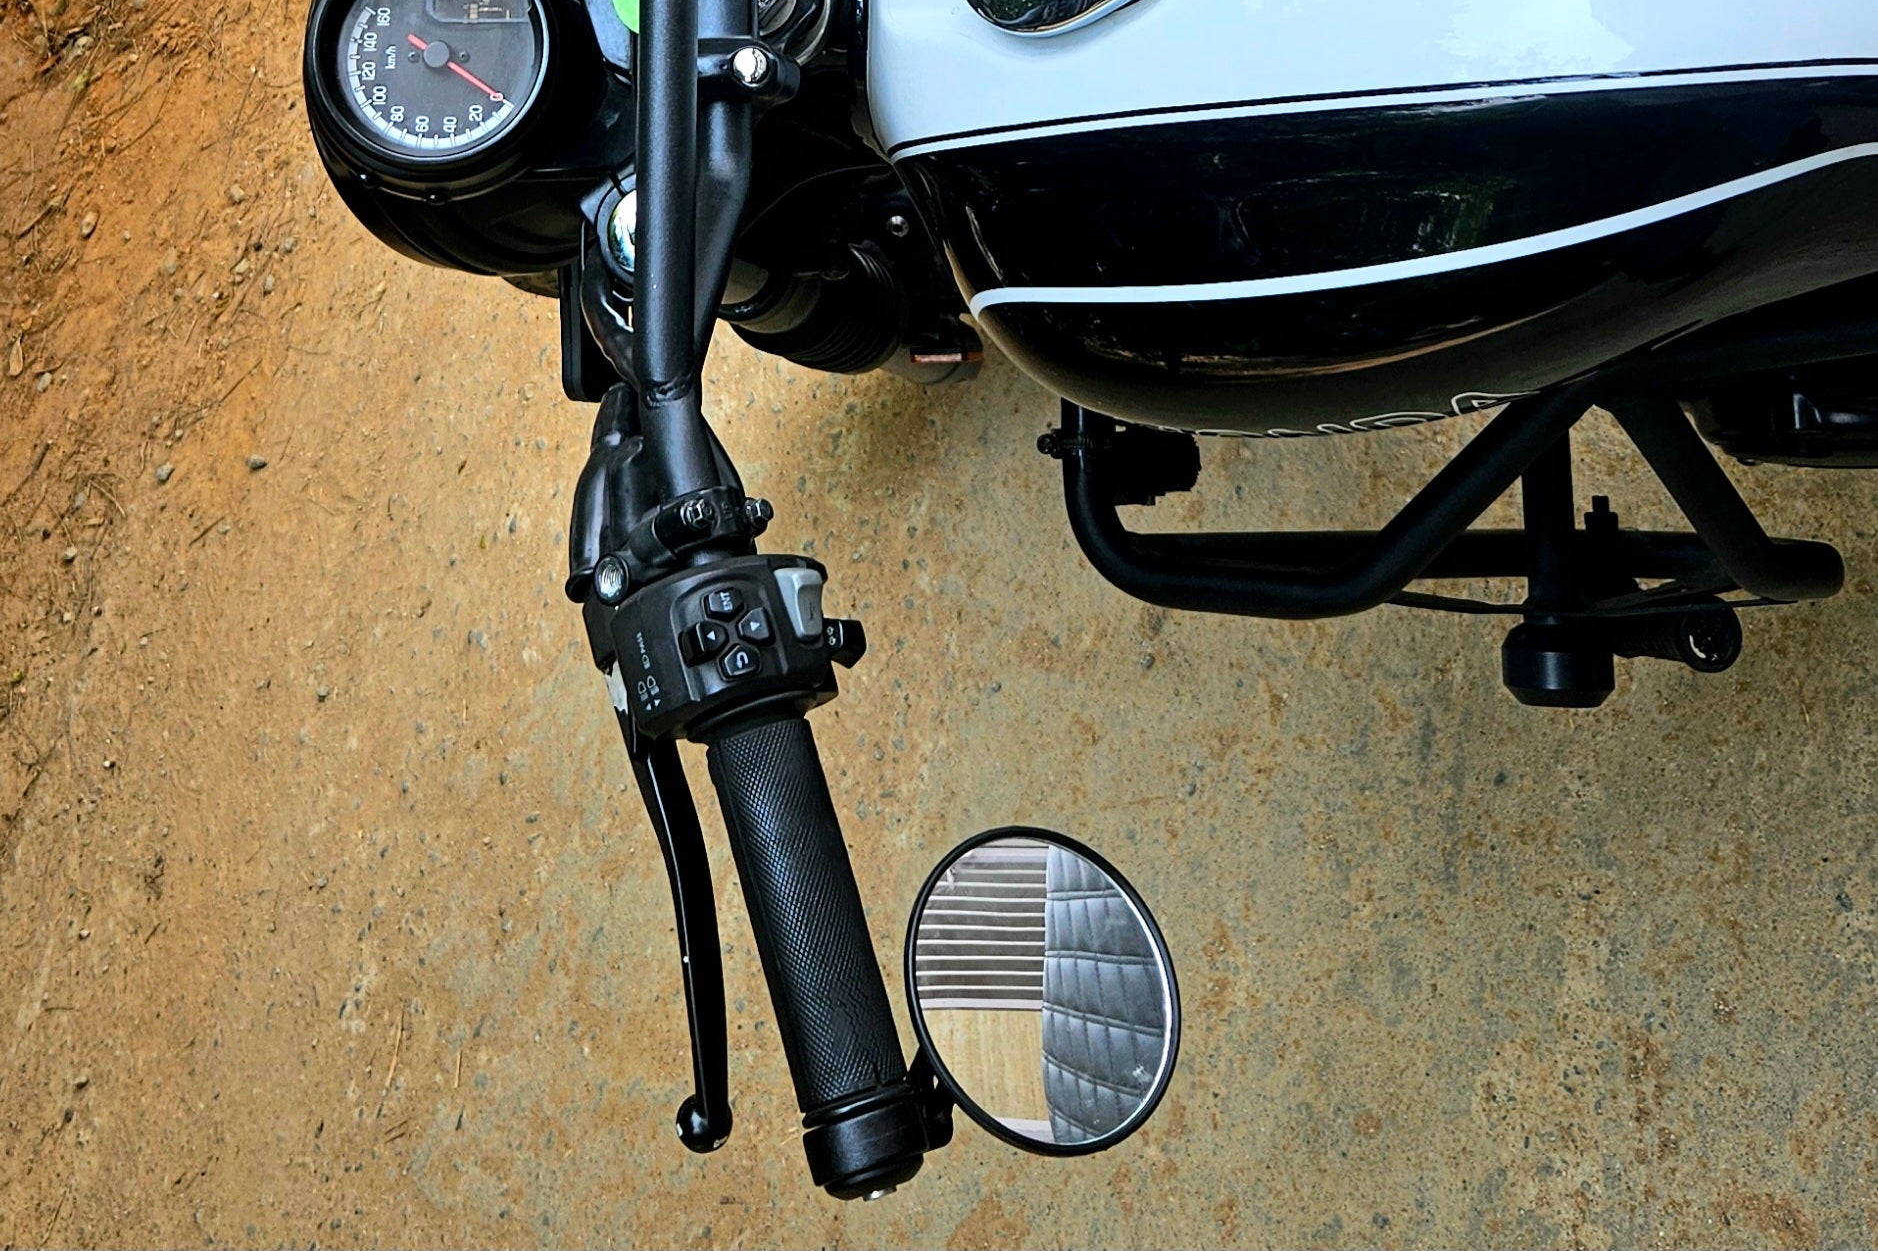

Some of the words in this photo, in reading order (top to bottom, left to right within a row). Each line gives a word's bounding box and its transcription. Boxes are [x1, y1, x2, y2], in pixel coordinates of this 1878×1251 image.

[377, 7, 391, 26] 160
[364, 32, 377, 51] 140
[386, 45, 396, 69] km/h
[362, 62, 375, 80] 120
[373, 86, 386, 105] 100
[391, 105, 405, 122] 80
[469, 105, 483, 121] 20
[416, 116, 429, 133] 60
[443, 116, 457, 133] 40
[720, 592, 733, 612] ENT
[637, 631, 646, 653] PASS
